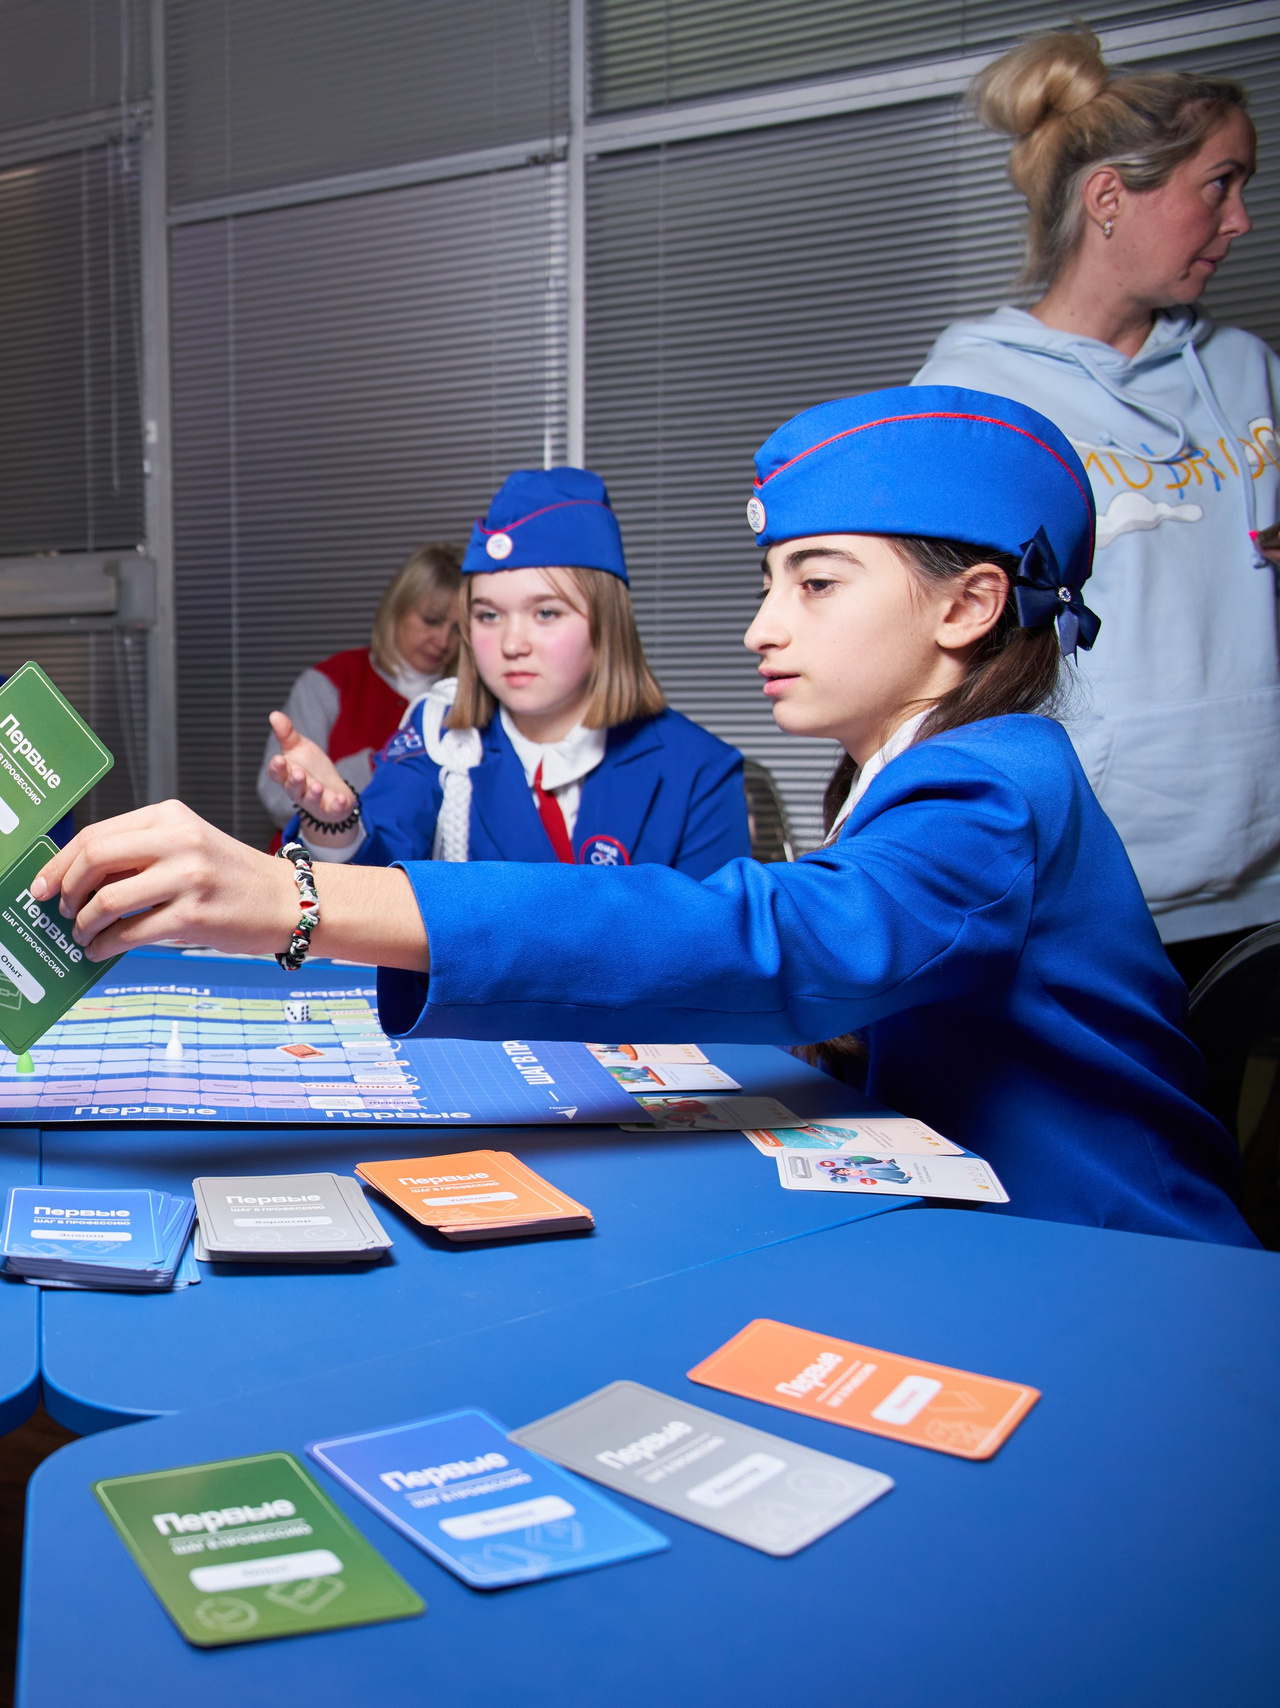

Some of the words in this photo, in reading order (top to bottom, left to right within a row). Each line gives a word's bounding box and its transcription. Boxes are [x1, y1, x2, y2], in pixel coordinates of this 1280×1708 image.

[0, 714, 61, 788] Первые
[1, 758, 41, 805] ПРОФЕССИЮ
[15, 888, 83, 962] Первые
[2, 911, 19, 927] ШАГ
[22, 932, 65, 978] ПРОФЕССИЮ
[0, 955, 22, 978] Опыт
[515, 1064, 556, 1085] ШАГ
[75, 1106, 217, 1116] Первые
[325, 1110, 471, 1120] Первые
[398, 1171, 489, 1187] Первые
[33, 1207, 130, 1217] Первые
[226, 1194, 321, 1206] Первые
[775, 1352, 843, 1398] Первые
[595, 1421, 693, 1470] Первые
[379, 1453, 508, 1492] Первые
[153, 1499, 296, 1535] Первые
